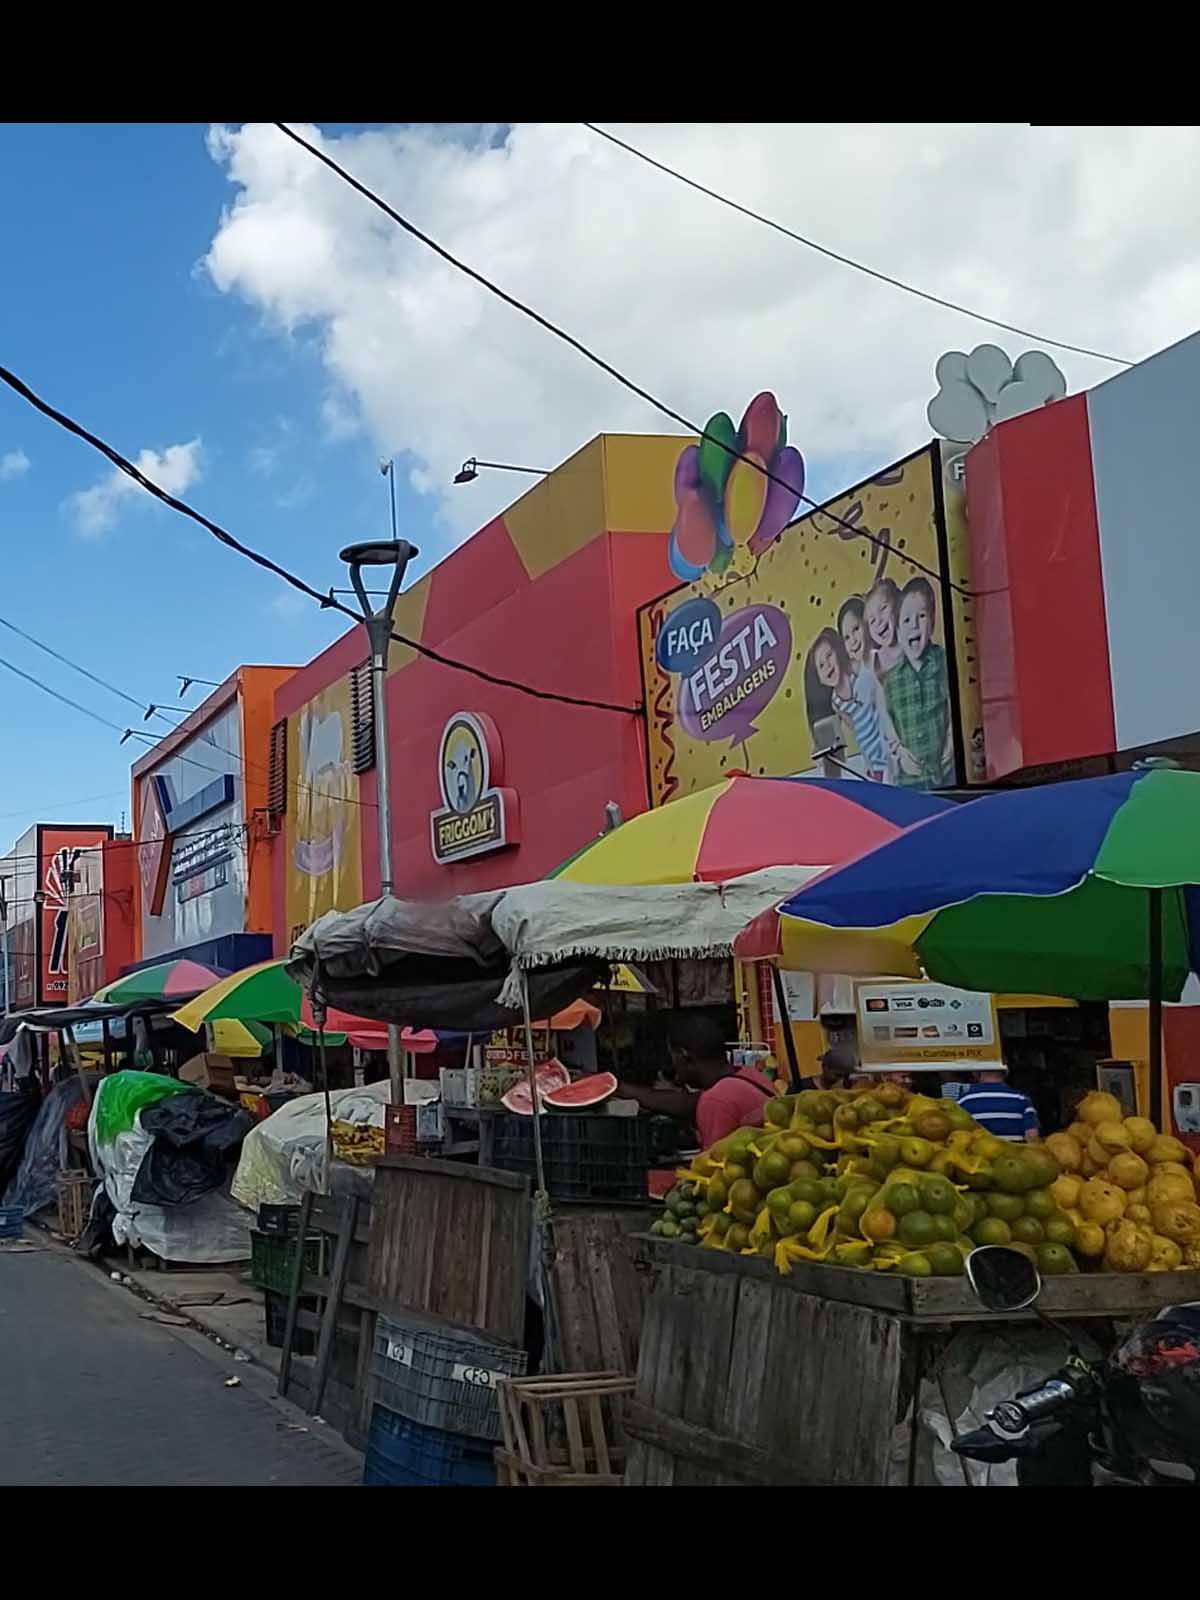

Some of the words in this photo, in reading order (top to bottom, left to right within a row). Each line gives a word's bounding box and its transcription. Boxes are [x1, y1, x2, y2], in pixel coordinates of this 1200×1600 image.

[667, 617, 713, 656] FAÇA
[689, 613, 777, 712] FESTA
[700, 660, 776, 730] EMBALAGENS
